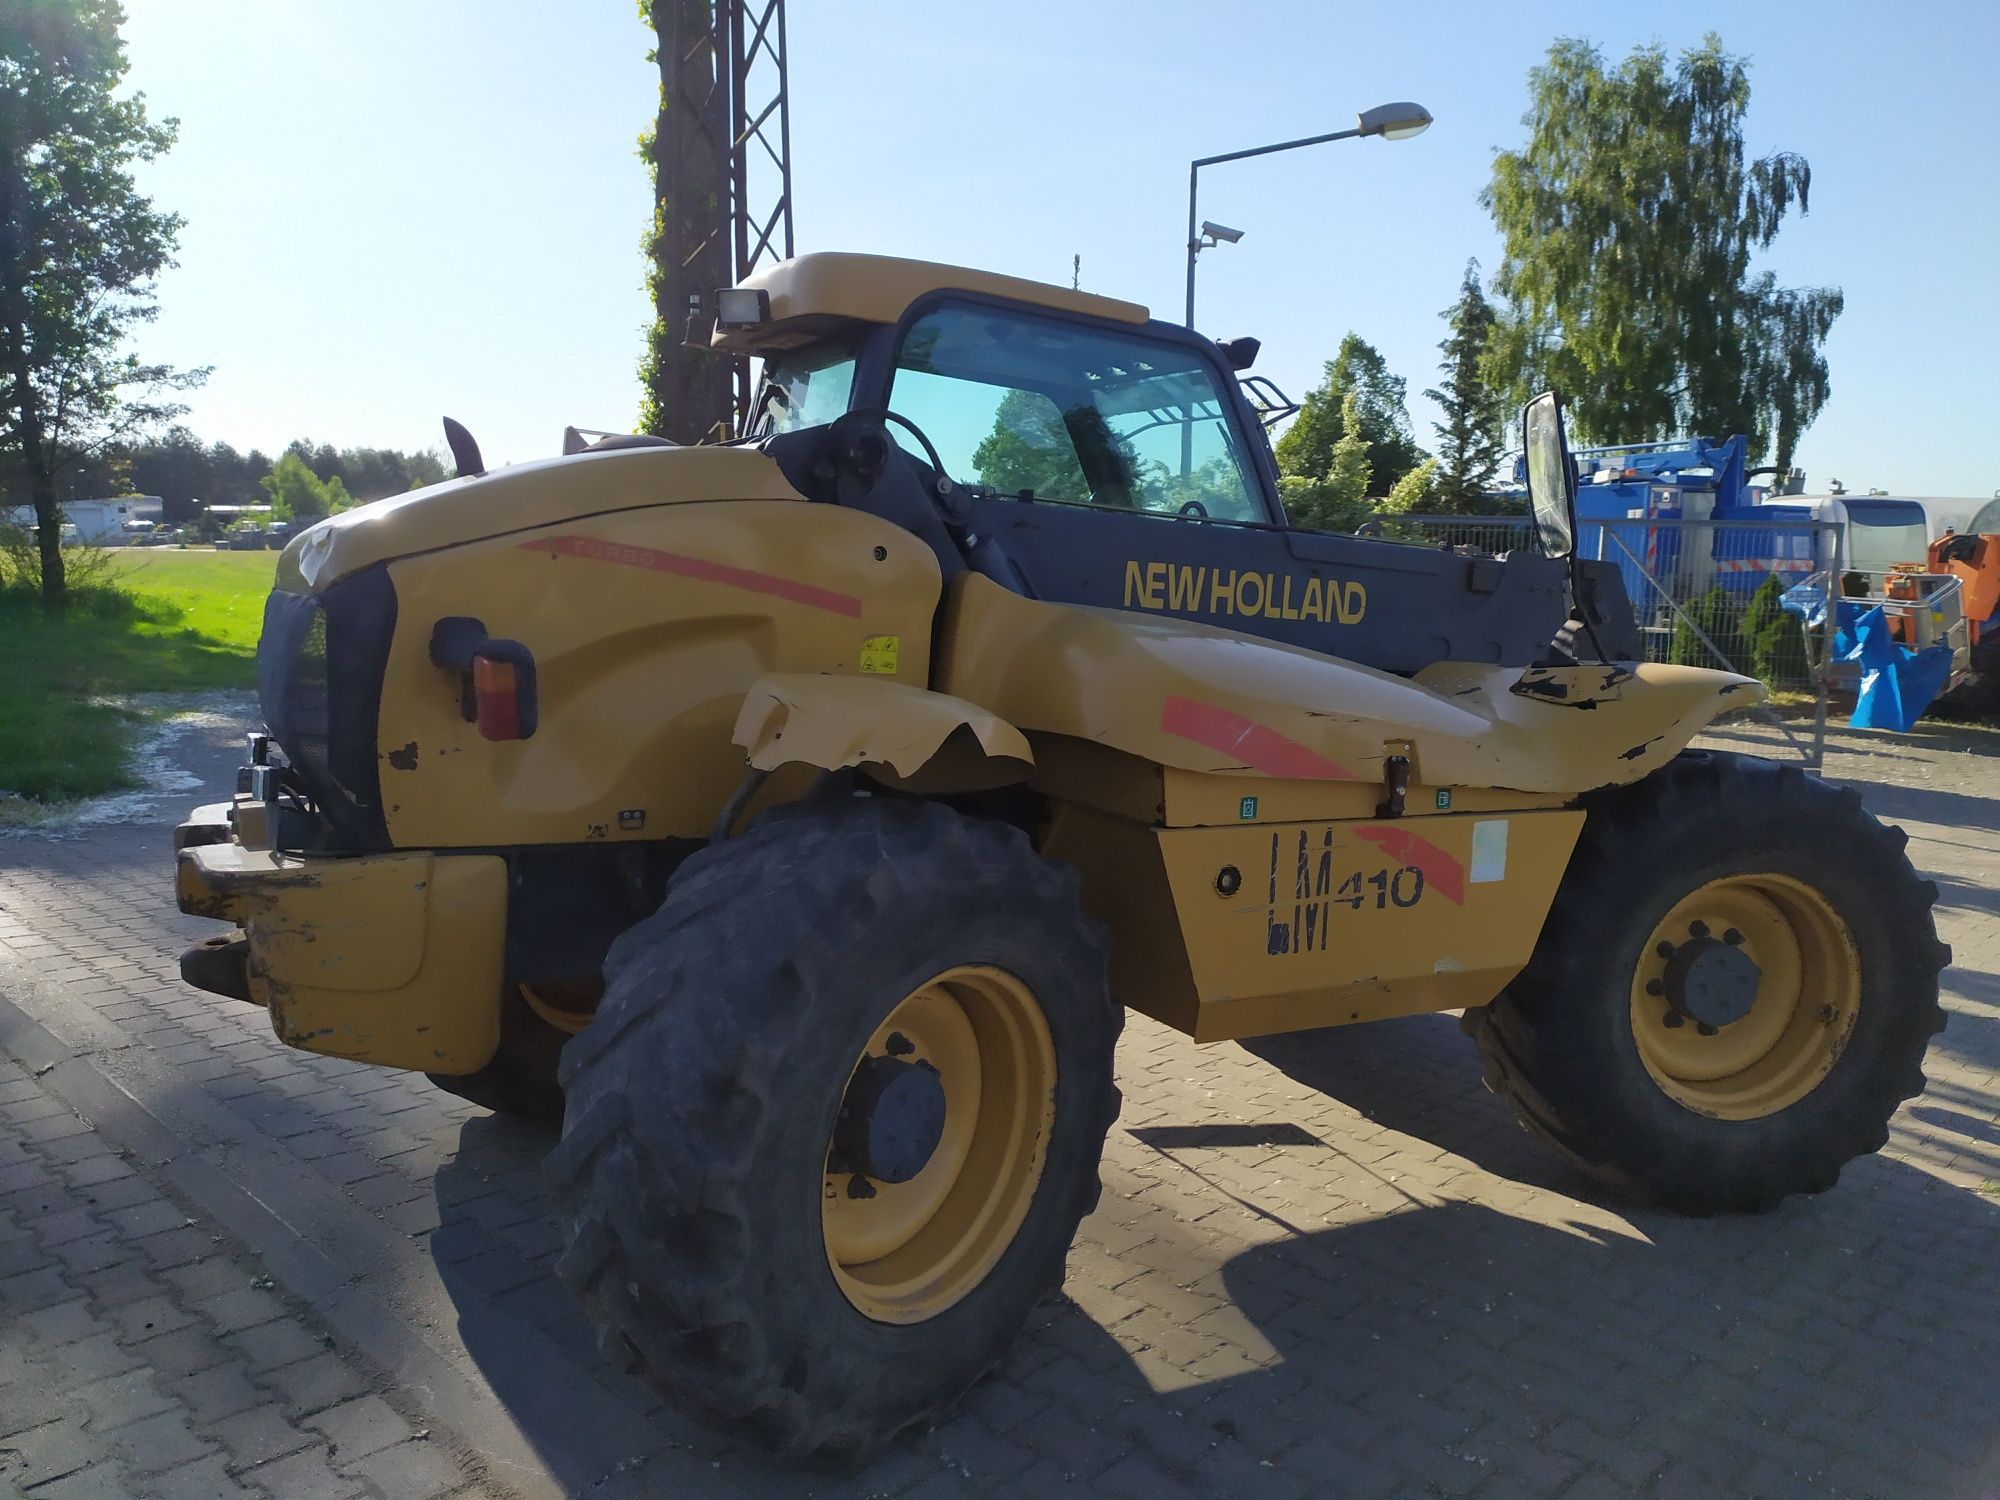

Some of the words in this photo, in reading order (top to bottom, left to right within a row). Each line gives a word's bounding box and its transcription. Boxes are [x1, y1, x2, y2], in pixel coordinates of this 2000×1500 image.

[1123, 560, 1206, 612] NEW
[1210, 568, 1367, 625] HOLLAND
[1334, 866, 1424, 910] 410
